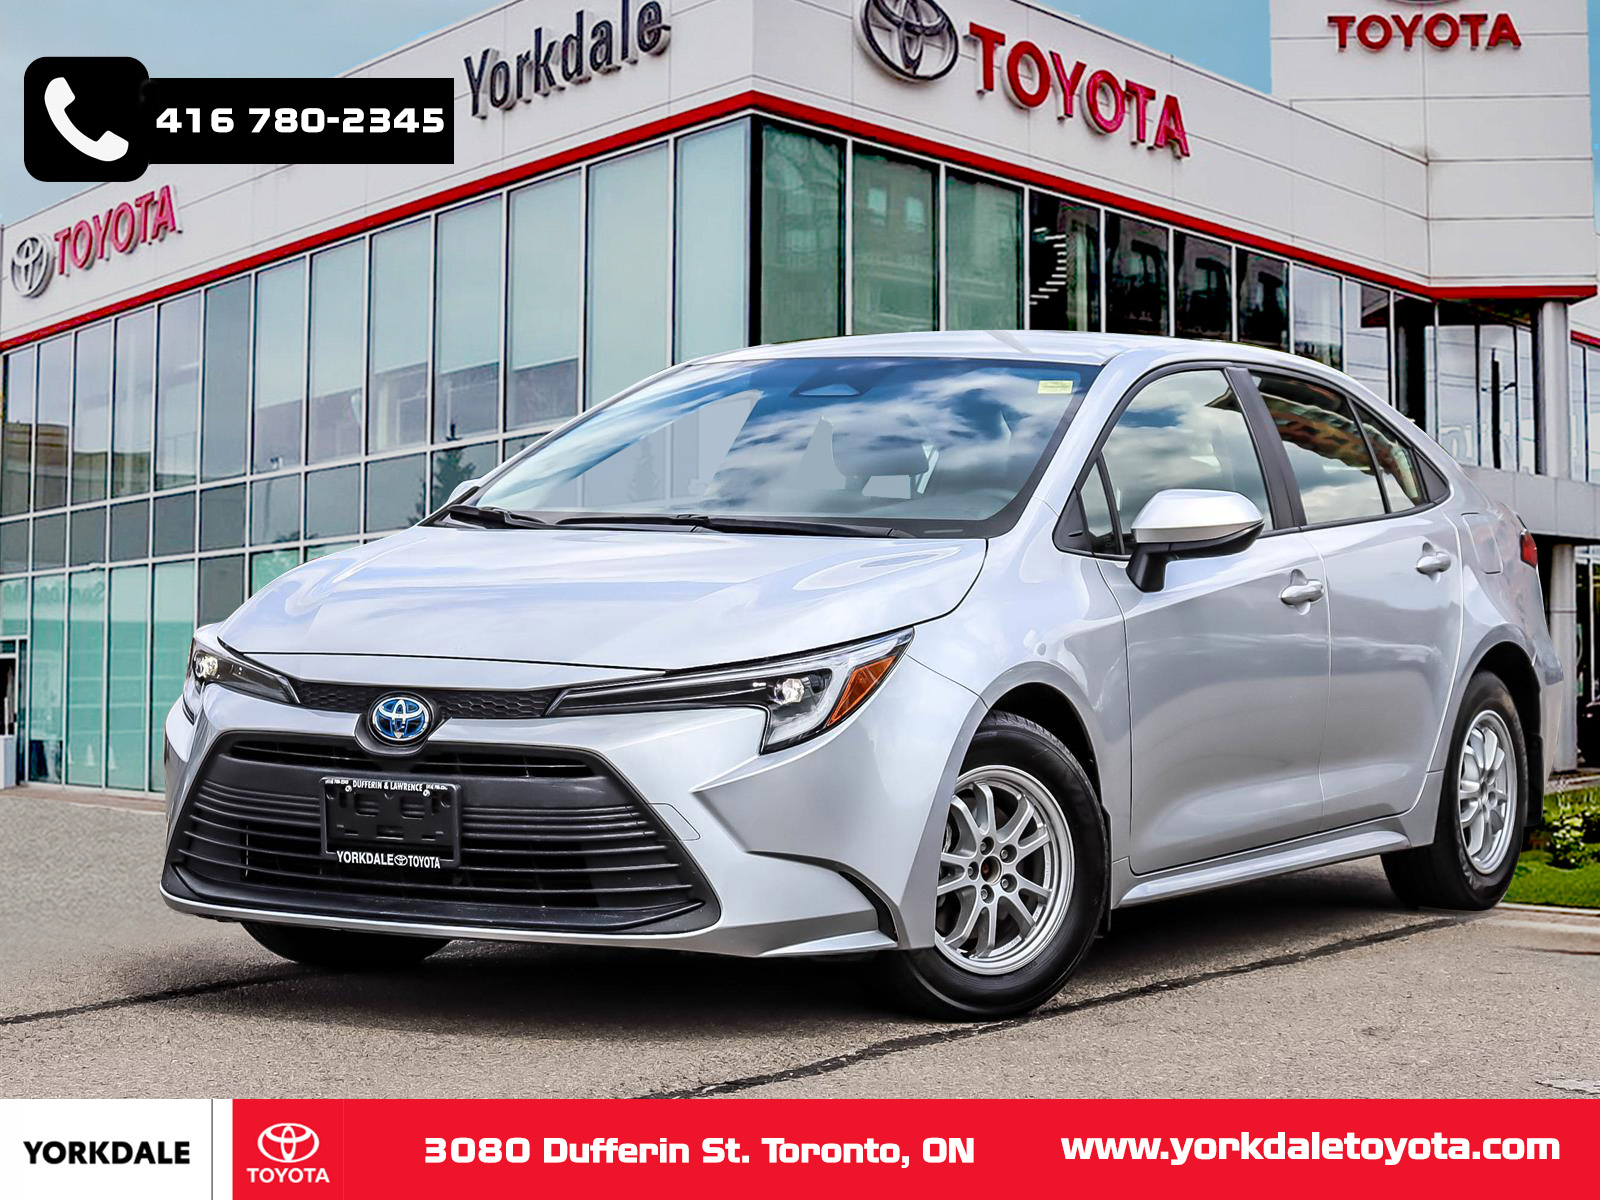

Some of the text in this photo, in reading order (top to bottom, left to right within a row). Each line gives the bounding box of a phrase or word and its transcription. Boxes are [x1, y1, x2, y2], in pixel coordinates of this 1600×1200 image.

[463, 0, 671, 119] Yorkdale
[1327, 12, 1522, 51] TOYOTA
[968, 22, 1190, 159] TOYOTA
[53, 184, 181, 277] TOYOTA
[352, 780, 382, 790] DUFFERIN
[383, 781, 390, 790] &
[390, 781, 423, 792] LAWRENCE
[336, 850, 441, 869] YORKDALE TOYOTA
